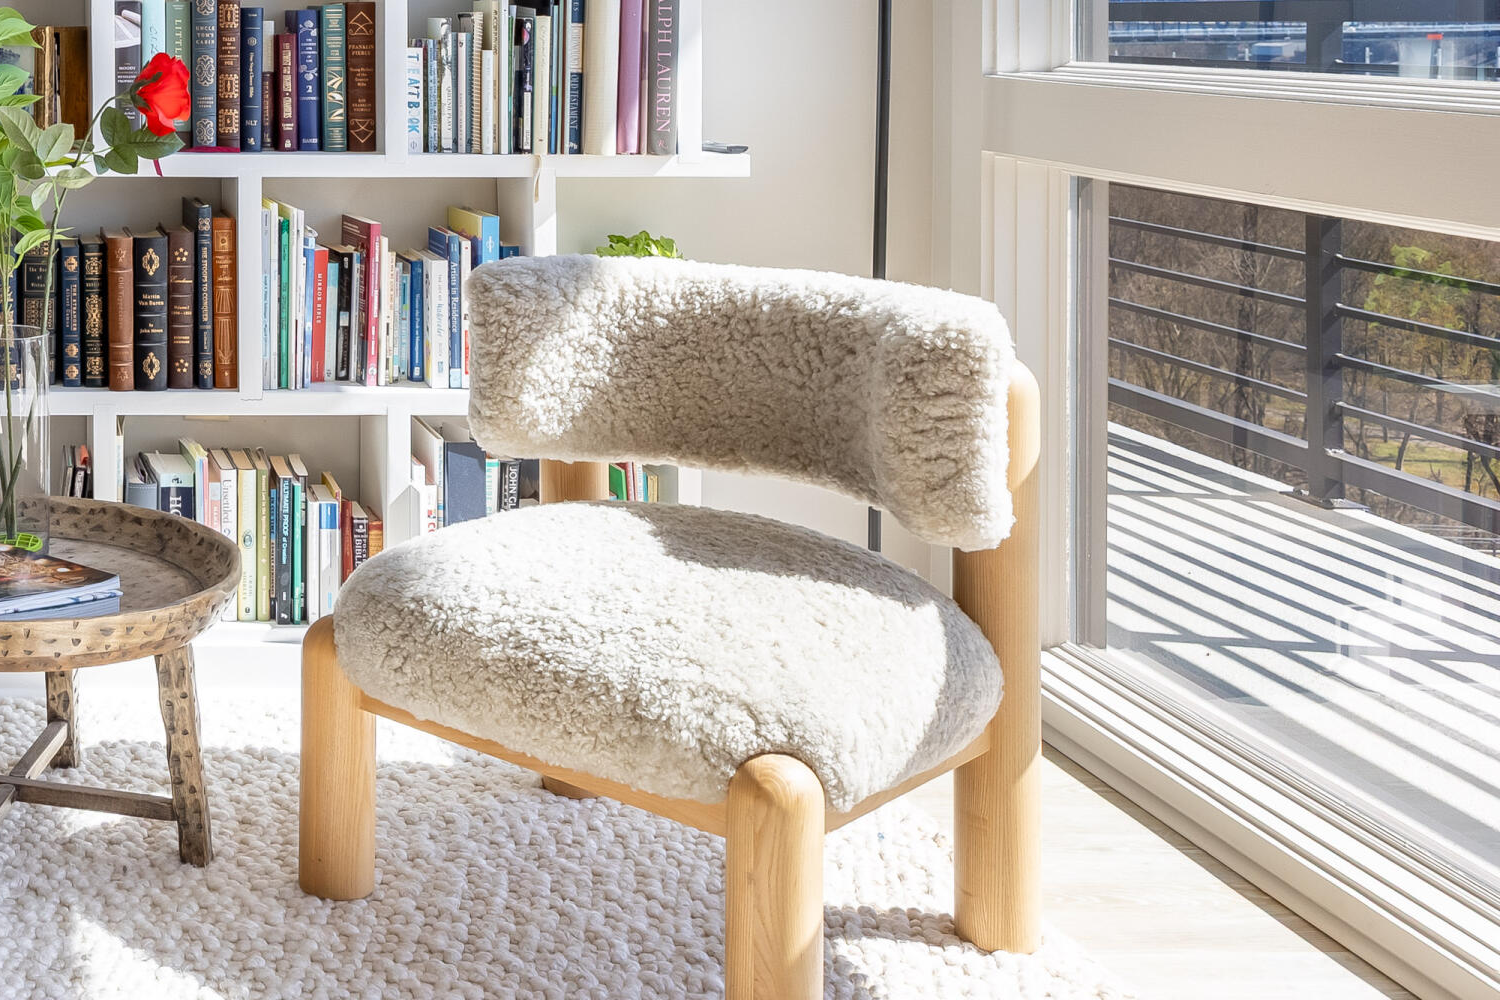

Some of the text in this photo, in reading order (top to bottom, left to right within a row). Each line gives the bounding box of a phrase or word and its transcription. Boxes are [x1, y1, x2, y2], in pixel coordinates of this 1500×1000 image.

[305, 85, 312, 93] 2
[569, 73, 579, 129] OLD TESTAMENT
[655, 52, 673, 133] LAUREN
[201, 283, 208, 291] TO
[450, 261, 461, 333] Artists in Residence
[508, 466, 519, 494] JOHN
[222, 479, 232, 524] Unsettled
[281, 482, 290, 513] ULTIMATE
[281, 514, 290, 536] PROOF
